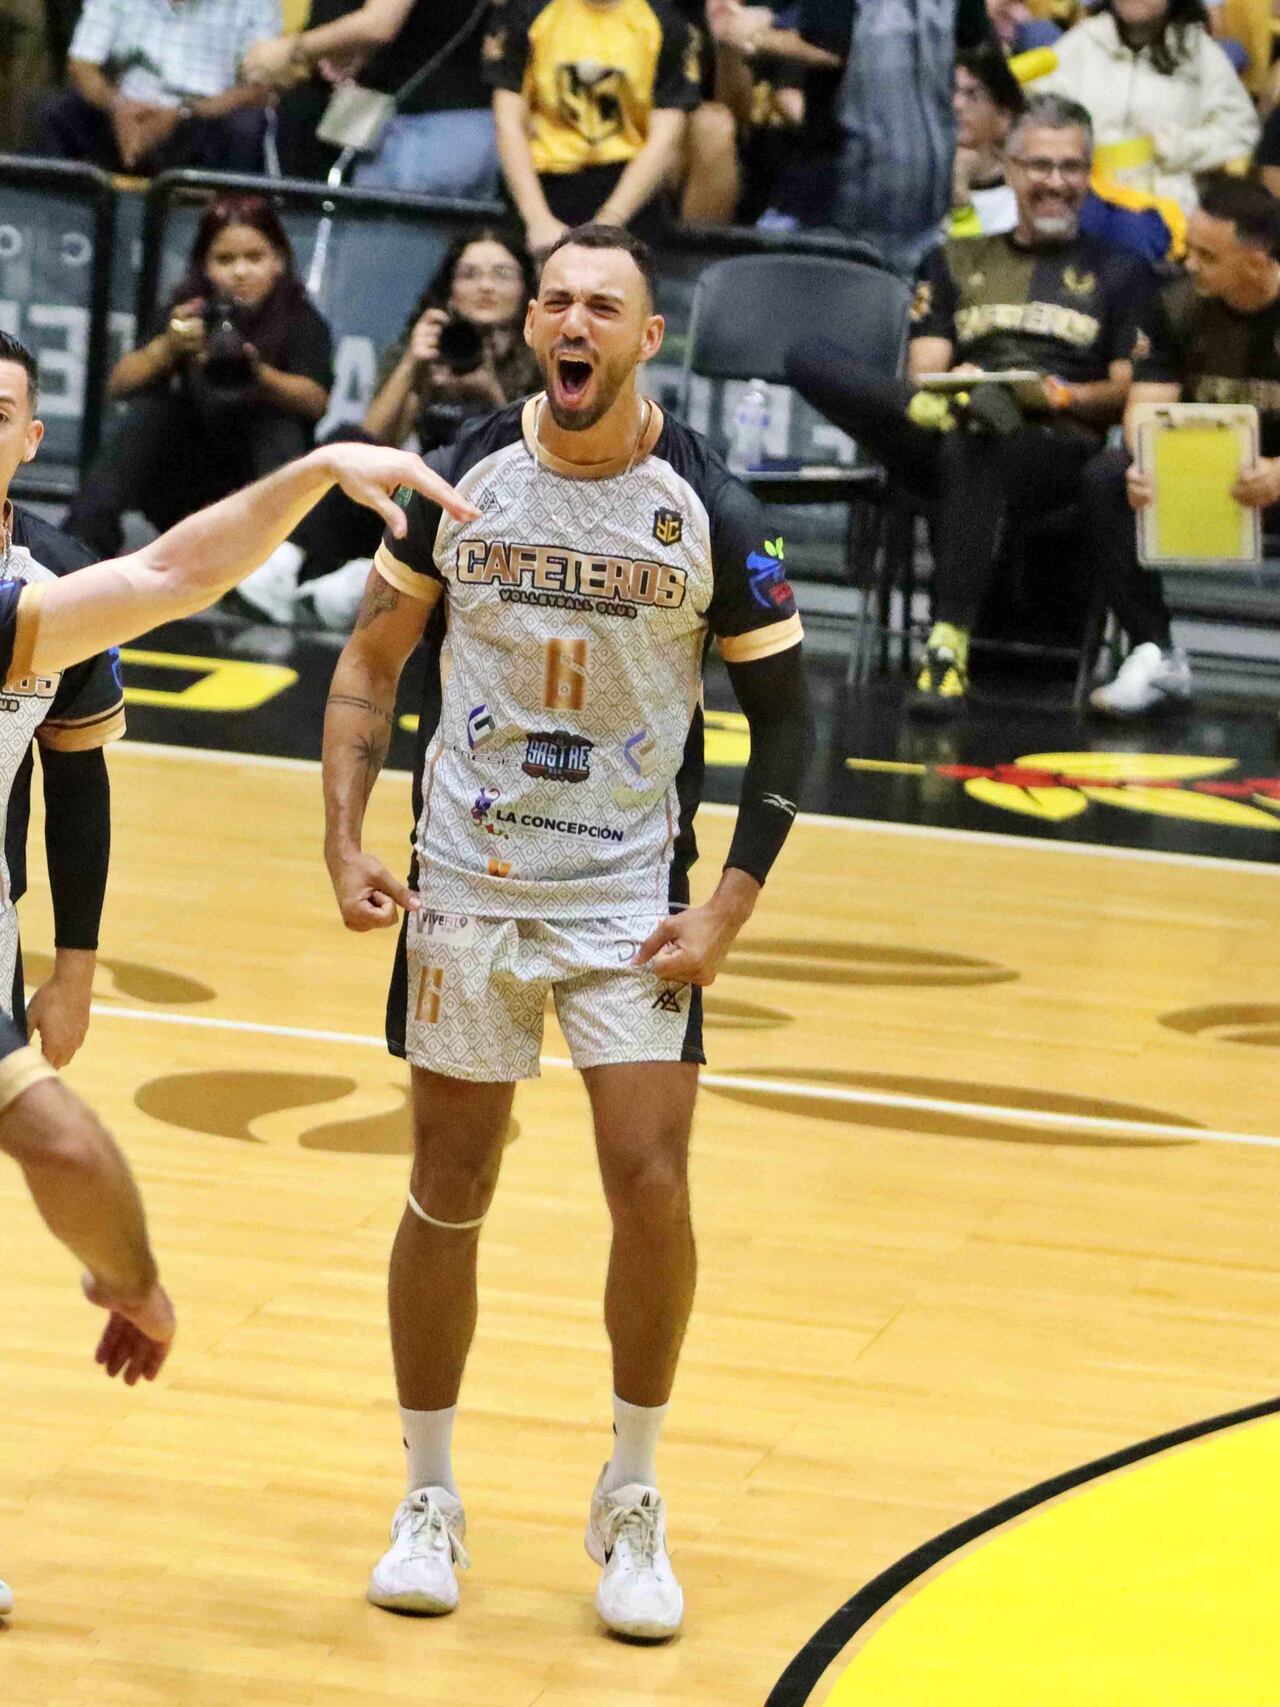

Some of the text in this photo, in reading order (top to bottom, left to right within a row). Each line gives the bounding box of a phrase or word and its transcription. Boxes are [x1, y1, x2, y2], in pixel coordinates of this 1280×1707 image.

[456, 540, 687, 608] CAFETEROS
[500, 589, 637, 619] VOLLEYBALL CLUB
[496, 810, 517, 824] LA
[521, 814, 624, 841] CONCEPCIÓN
